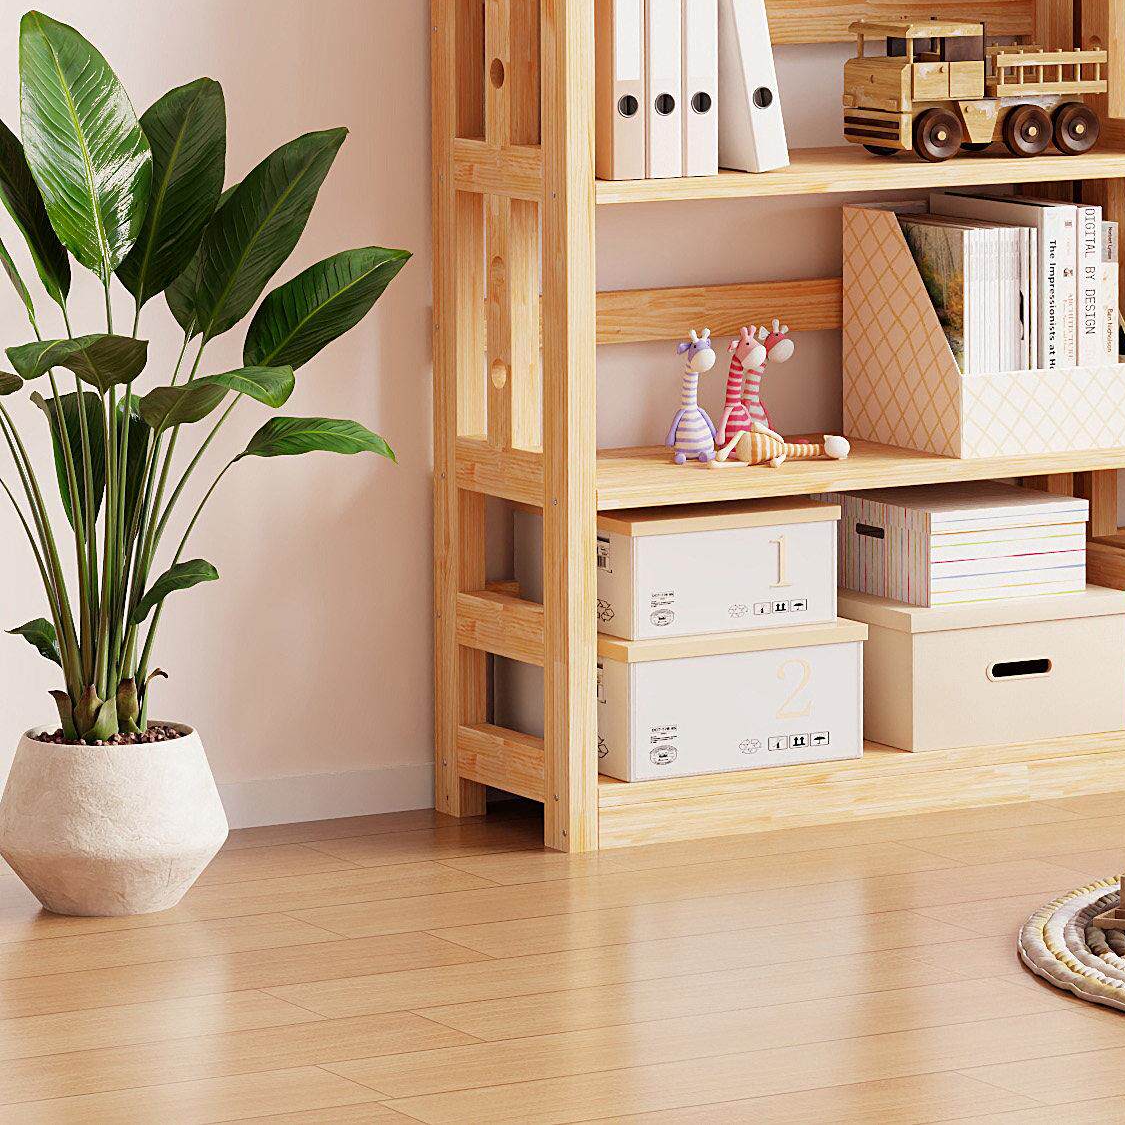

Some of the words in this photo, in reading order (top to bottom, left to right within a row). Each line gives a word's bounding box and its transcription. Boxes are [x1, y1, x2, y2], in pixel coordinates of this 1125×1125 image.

[1049, 240, 1057, 259] The
[1085, 208, 1096, 259] DIGITAL
[1085, 266, 1096, 281] BY
[1048, 263, 1057, 341] Impressionists
[1085, 289, 1096, 335] DESIGN
[1049, 344, 1056, 355] at
[776, 658, 812, 720] 2
